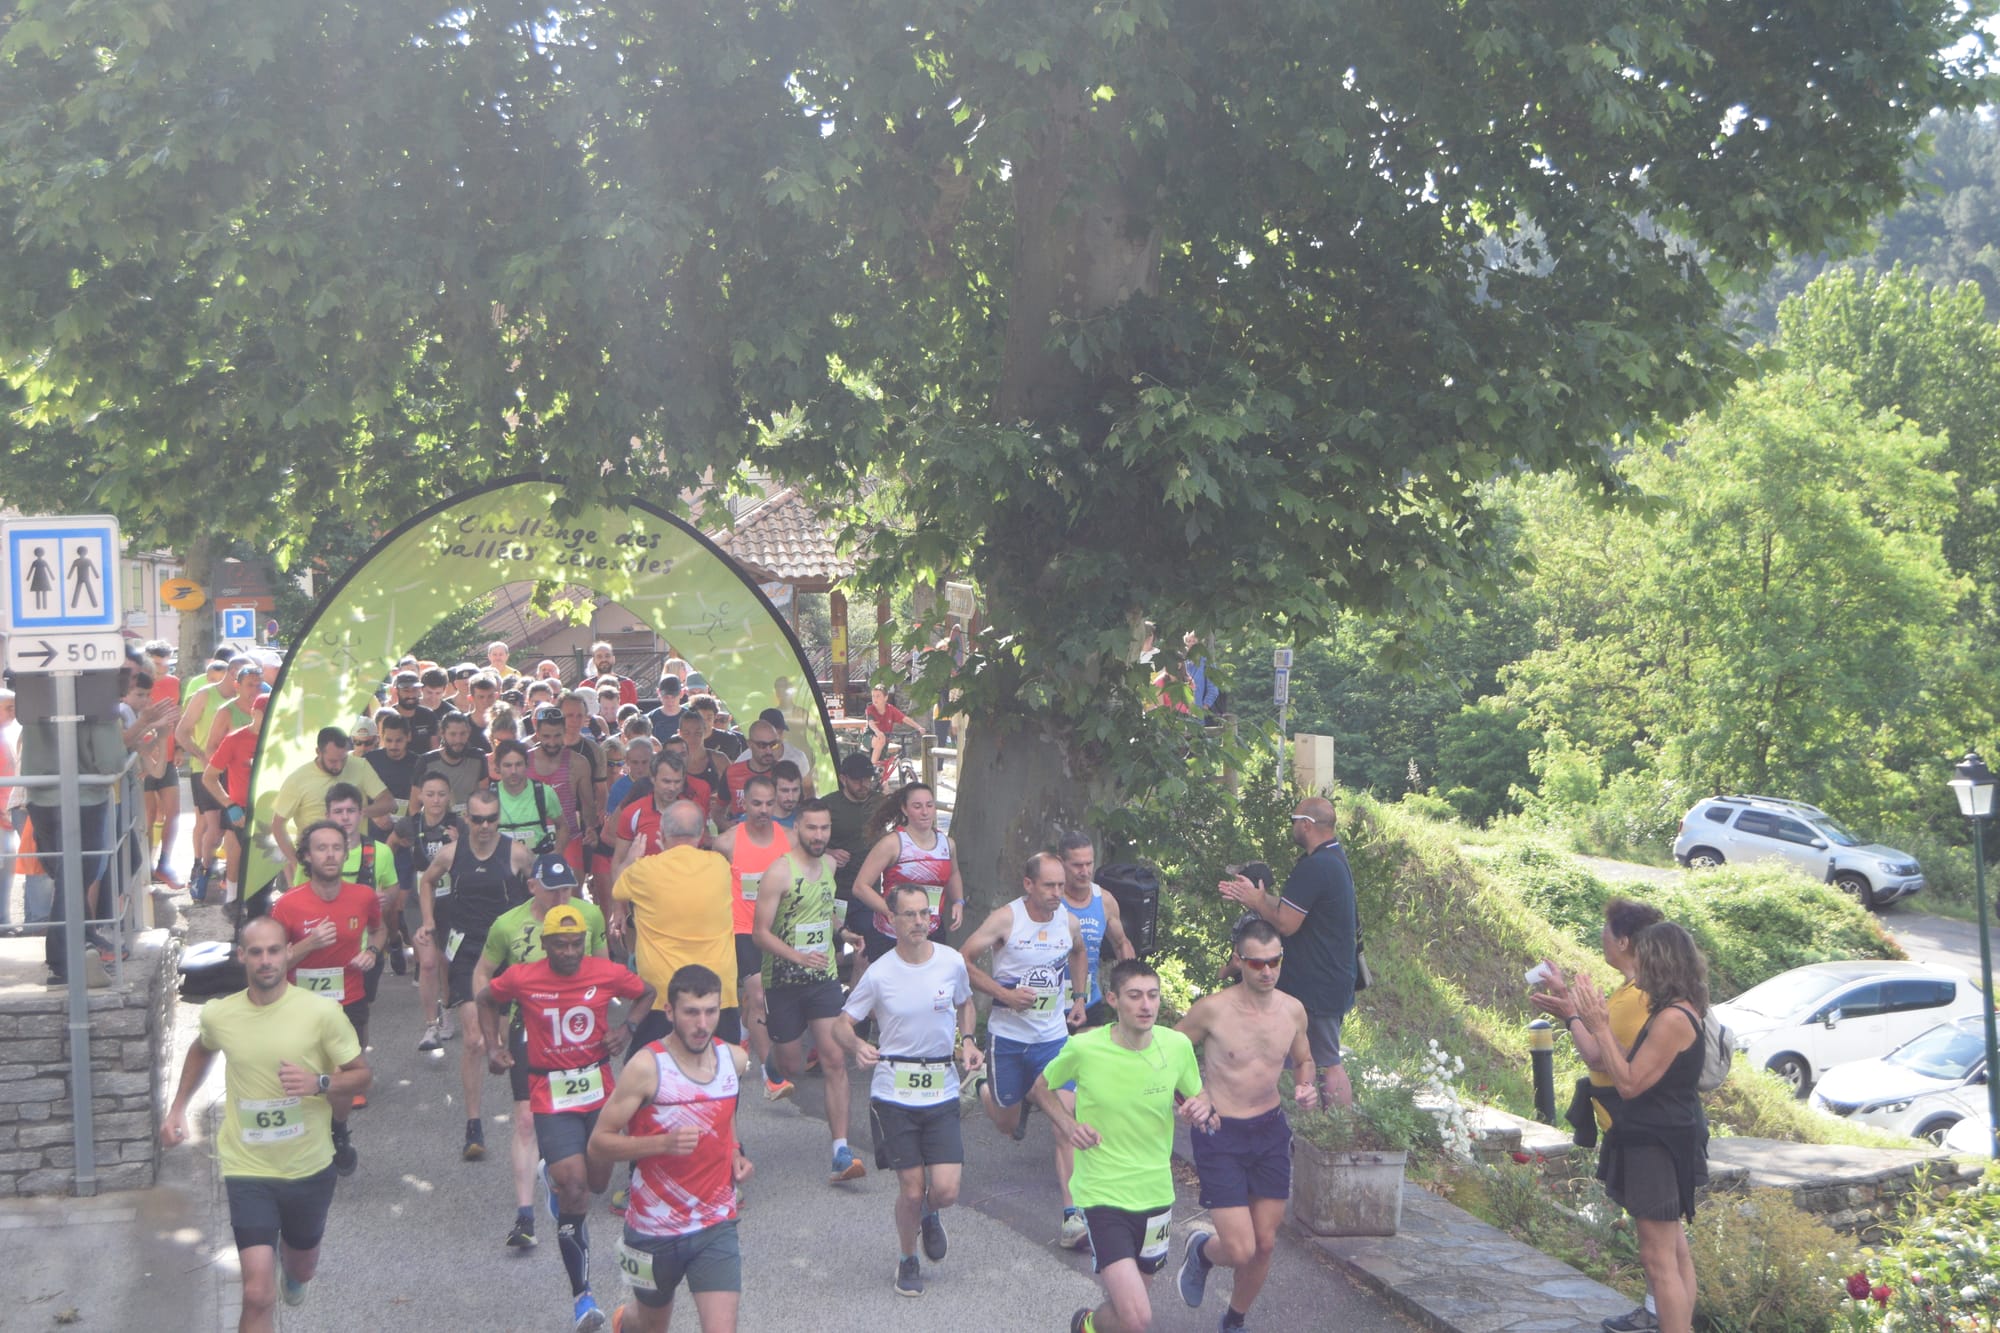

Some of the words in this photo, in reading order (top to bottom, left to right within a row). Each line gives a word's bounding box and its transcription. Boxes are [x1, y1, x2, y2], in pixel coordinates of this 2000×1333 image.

[232, 614, 247, 634] P
[67, 643, 98, 662] 50
[101, 649, 117, 661] m
[806, 930, 824, 945] 23
[308, 977, 332, 991] 72
[543, 1005, 595, 1046] 10
[565, 1078, 591, 1095] 29
[908, 1073, 933, 1089] 58
[256, 1110, 287, 1128] 63
[620, 1251, 639, 1276] 20
